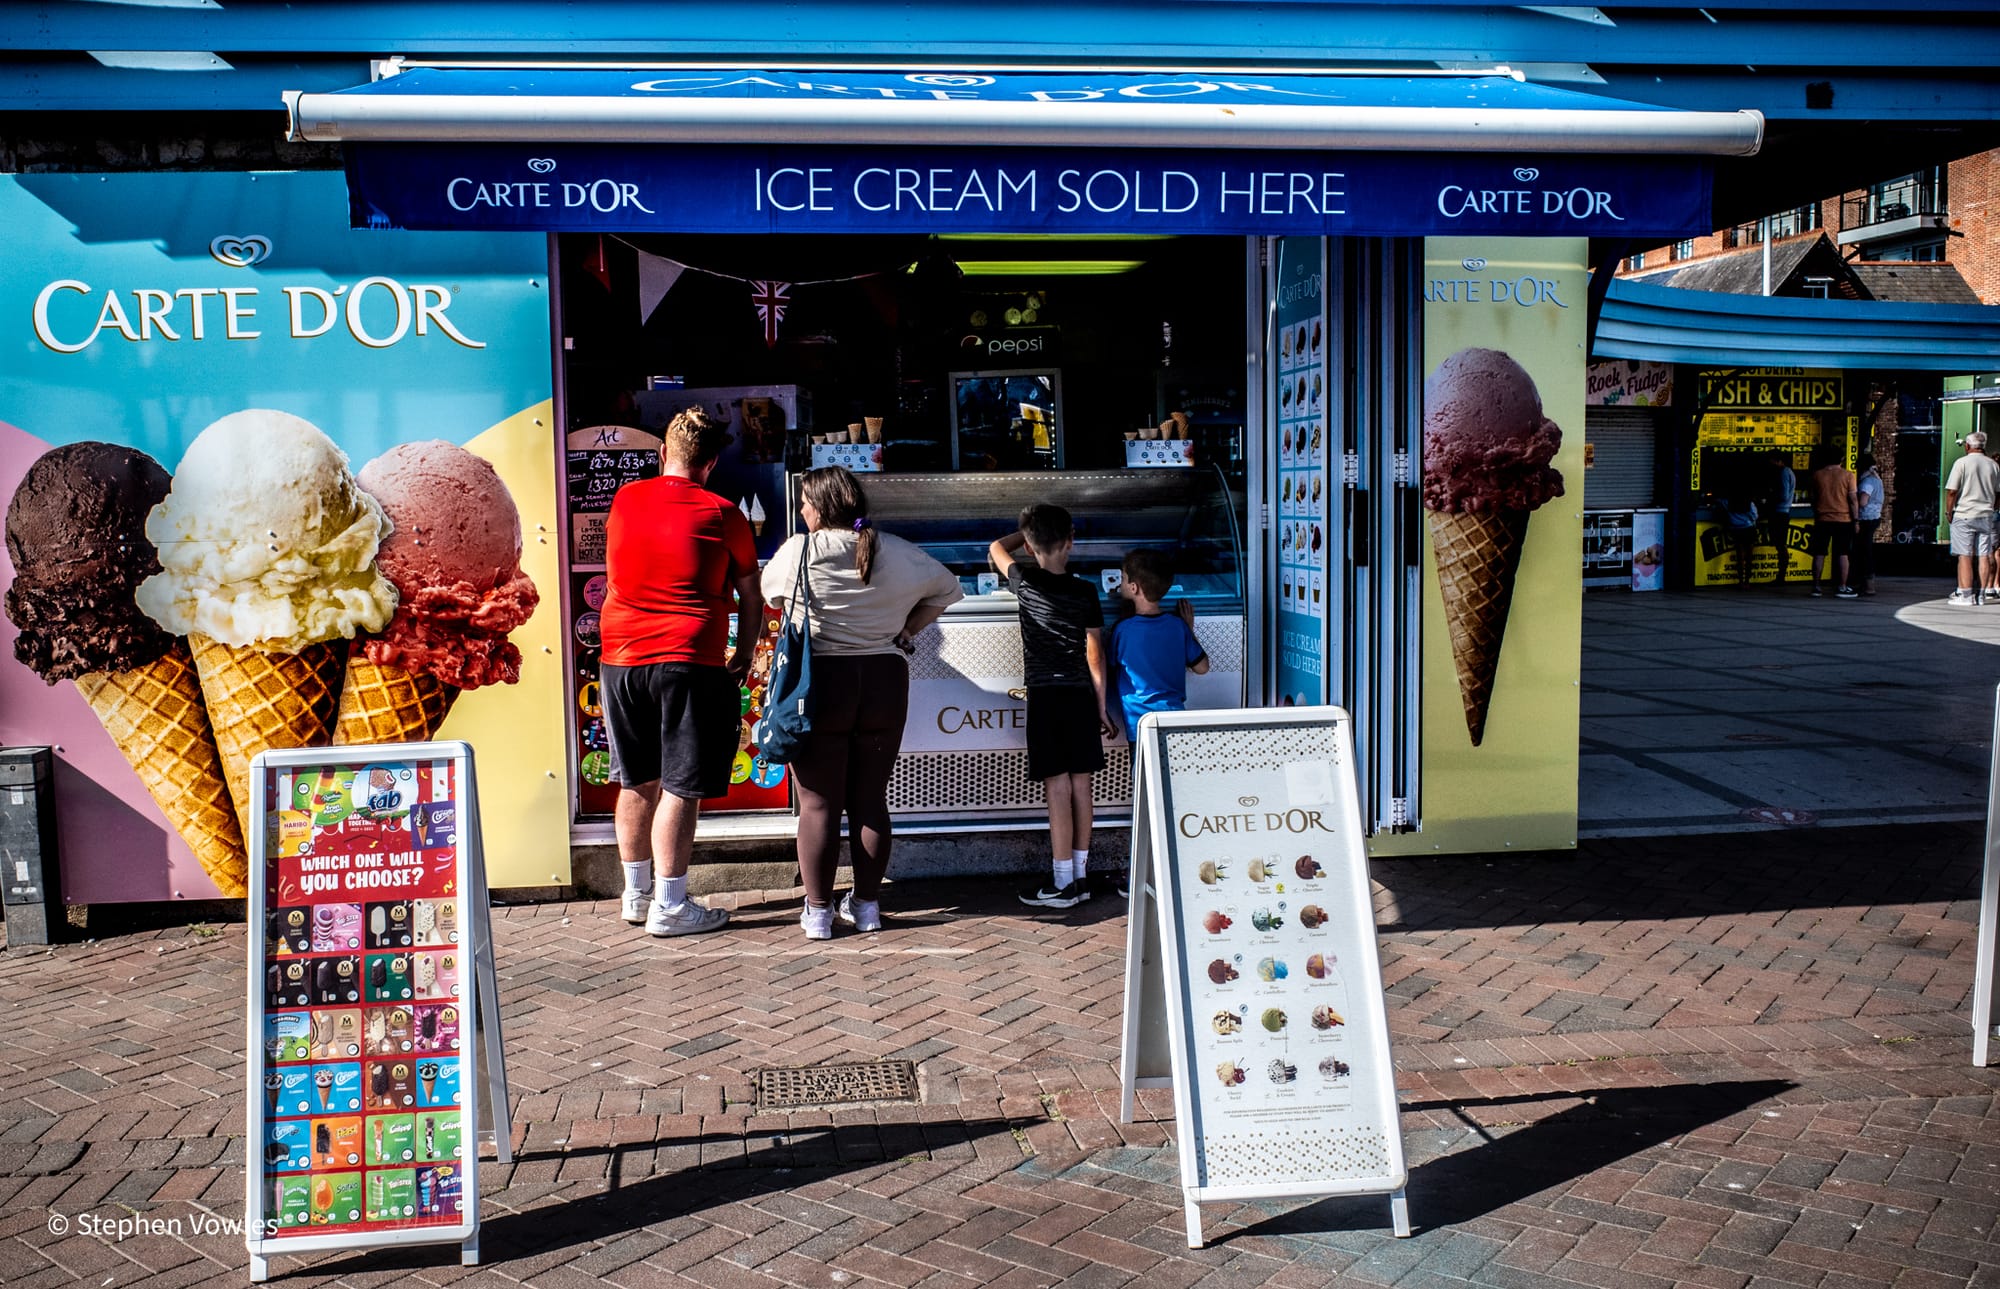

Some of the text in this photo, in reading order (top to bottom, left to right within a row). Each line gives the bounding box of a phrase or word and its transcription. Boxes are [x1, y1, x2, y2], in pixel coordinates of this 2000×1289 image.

[447, 177, 655, 214] CARTE D'OR
[754, 168, 1346, 214] ICE CREAM SOLD HERE
[1438, 185, 1624, 220] CARTE D'OR
[33, 279, 261, 353] CARTE
[988, 336, 1042, 356] pepsi
[1588, 368, 1667, 395] Rock Fudge
[1758, 382, 1773, 404] &
[1779, 381, 1836, 404] CHIPS
[593, 428, 619, 447] Art
[937, 706, 1025, 734] CARTE
[367, 791, 402, 812] fab
[1180, 809, 1335, 838] CARTE D'OR
[301, 851, 424, 872] WHICH ONE WILL
[301, 868, 424, 895] YOU CHOOSE?
